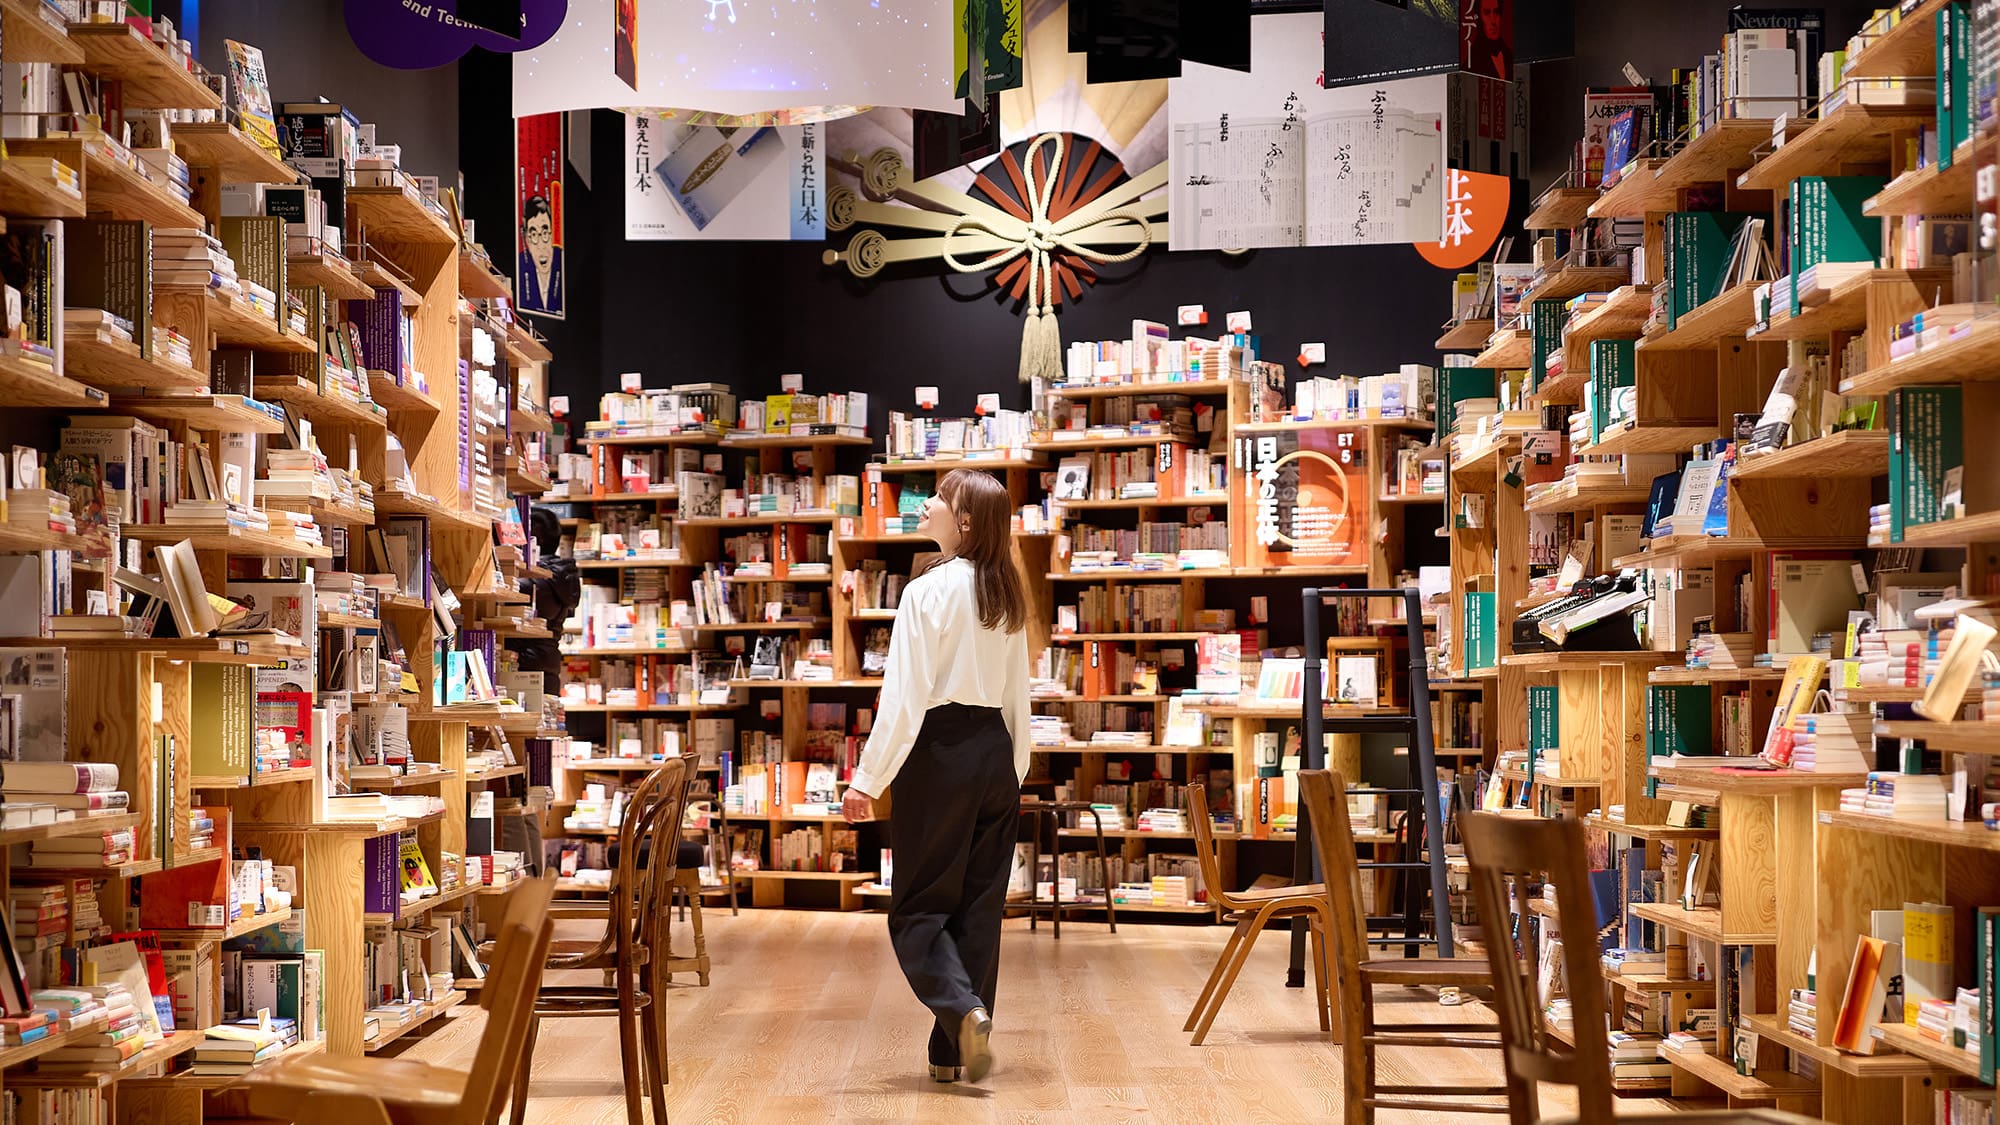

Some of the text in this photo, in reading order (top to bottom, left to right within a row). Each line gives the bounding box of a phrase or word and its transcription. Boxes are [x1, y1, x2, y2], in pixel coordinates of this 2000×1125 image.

[402, 0, 432, 18] and
[1733, 13, 1797, 28] Newton
[1337, 433, 1354, 447] ET
[1341, 449, 1351, 464] 5
[1255, 436, 1279, 546] 日本の正体
